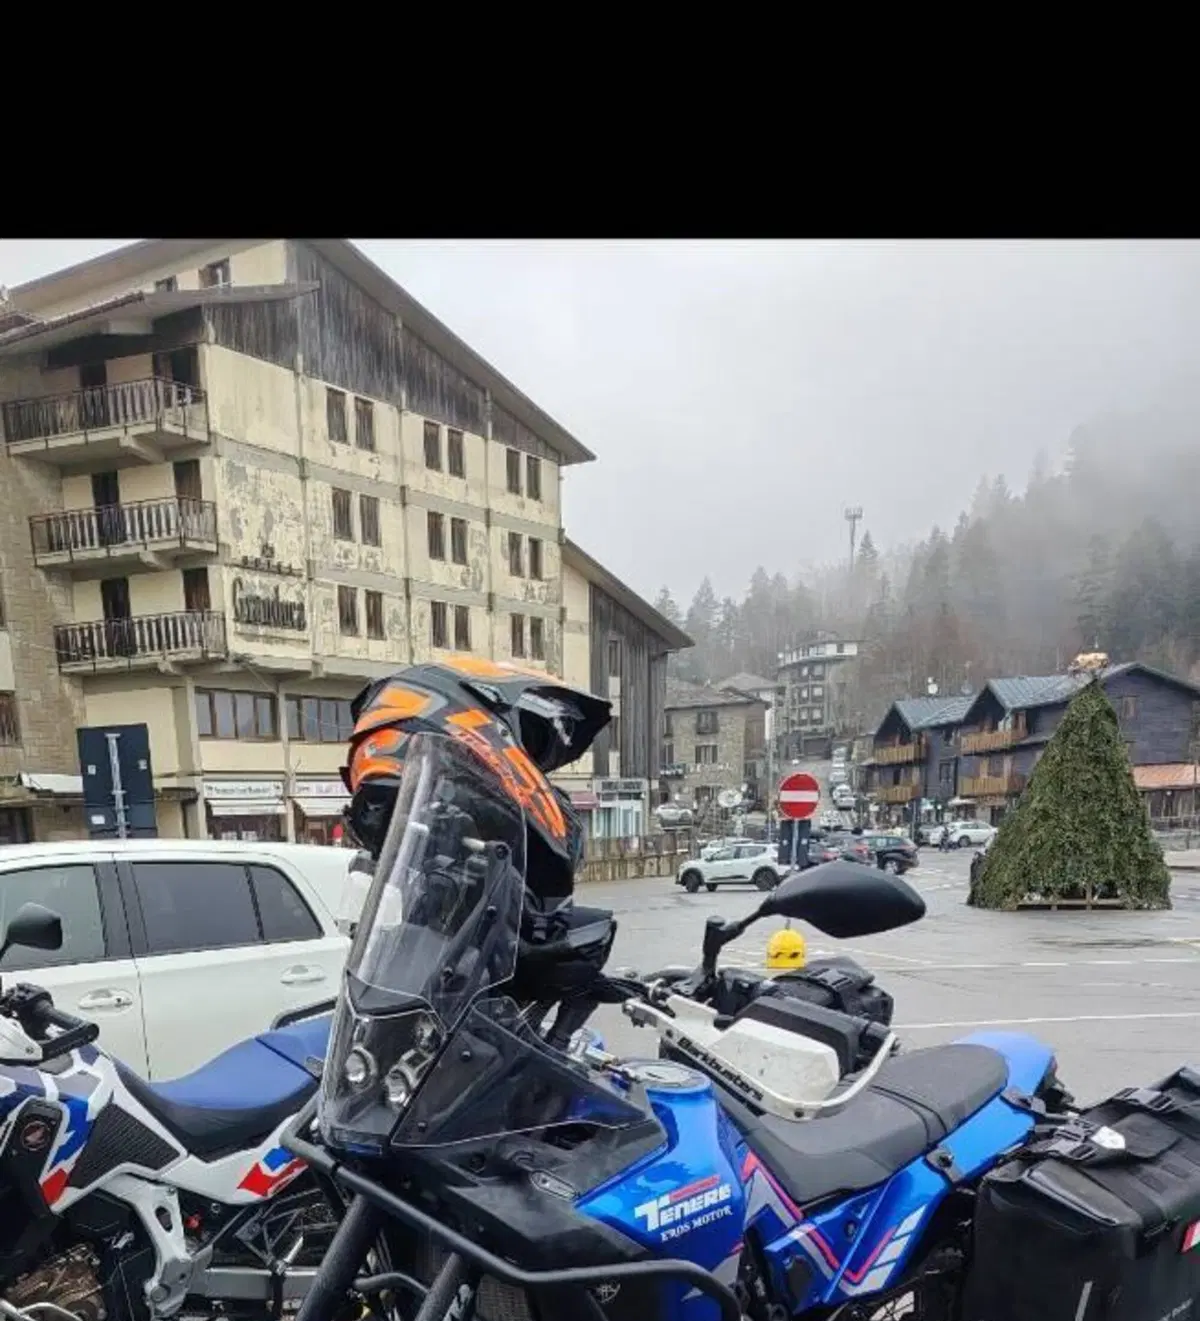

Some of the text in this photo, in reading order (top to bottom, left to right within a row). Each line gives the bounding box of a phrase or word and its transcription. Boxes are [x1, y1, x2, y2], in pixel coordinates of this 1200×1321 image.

[677, 1036, 764, 1101] Barkbusters
[660, 1205, 733, 1243] EROS MOTOR
